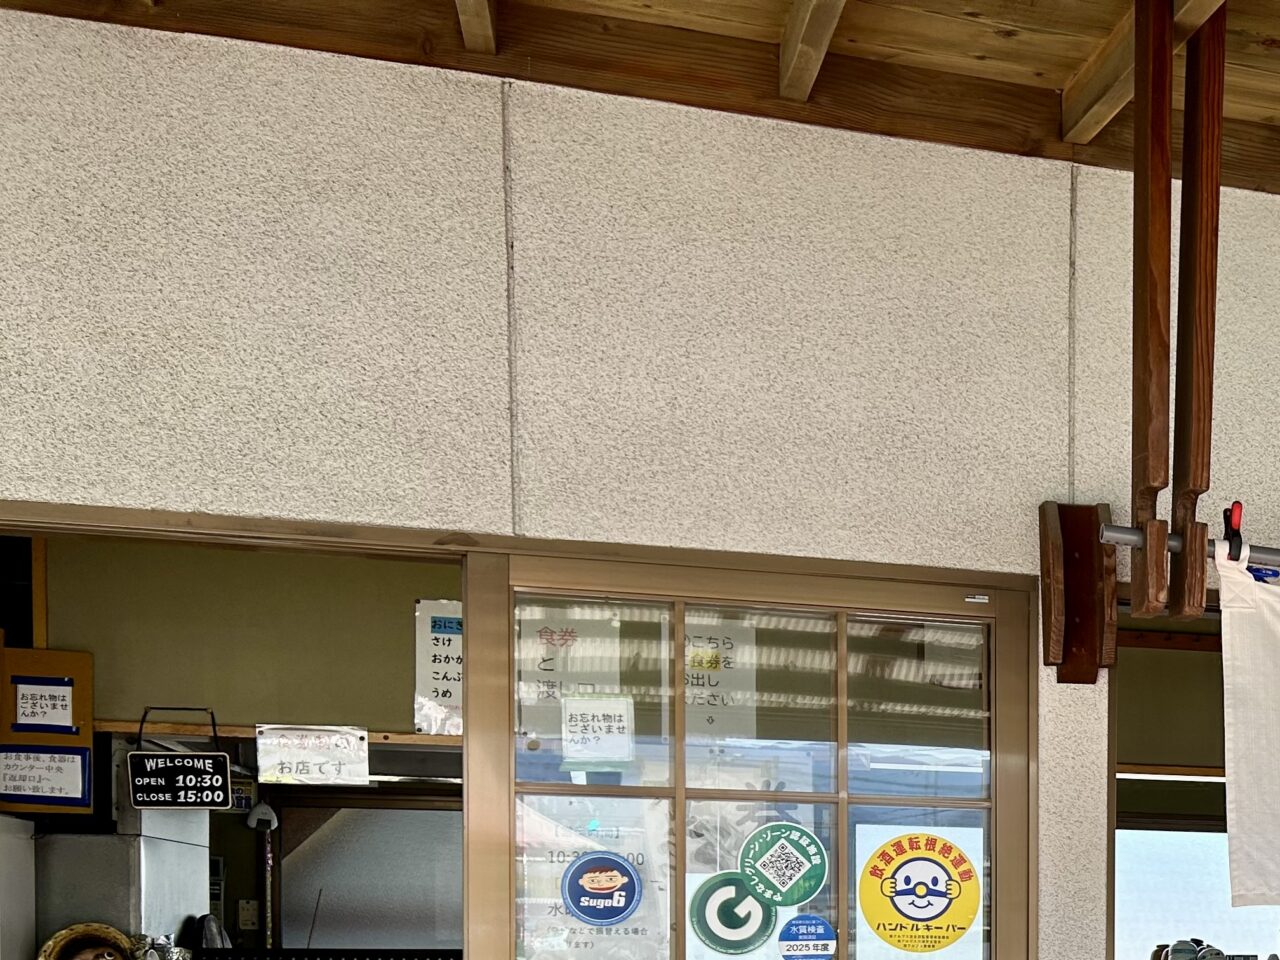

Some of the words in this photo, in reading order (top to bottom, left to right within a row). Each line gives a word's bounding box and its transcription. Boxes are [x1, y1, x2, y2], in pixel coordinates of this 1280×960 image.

[432, 636, 452, 647] さけ
[536, 626, 578, 647] 食券
[20, 693, 67, 701] お忘れ物は
[432, 688, 452, 699] うめ
[20, 701, 68, 711] ございませ
[568, 713, 624, 723] お忘れ物は
[568, 723, 627, 734] ございませ
[144, 758, 214, 772] WELCOME
[277, 760, 346, 775] お店です
[135, 777, 166, 786] OPEN
[175, 775, 222, 787] 10:30
[136, 793, 172, 801] CLOSE
[177, 790, 224, 802] 15:00
[869, 836, 974, 882] 飲酒運転根絶運動
